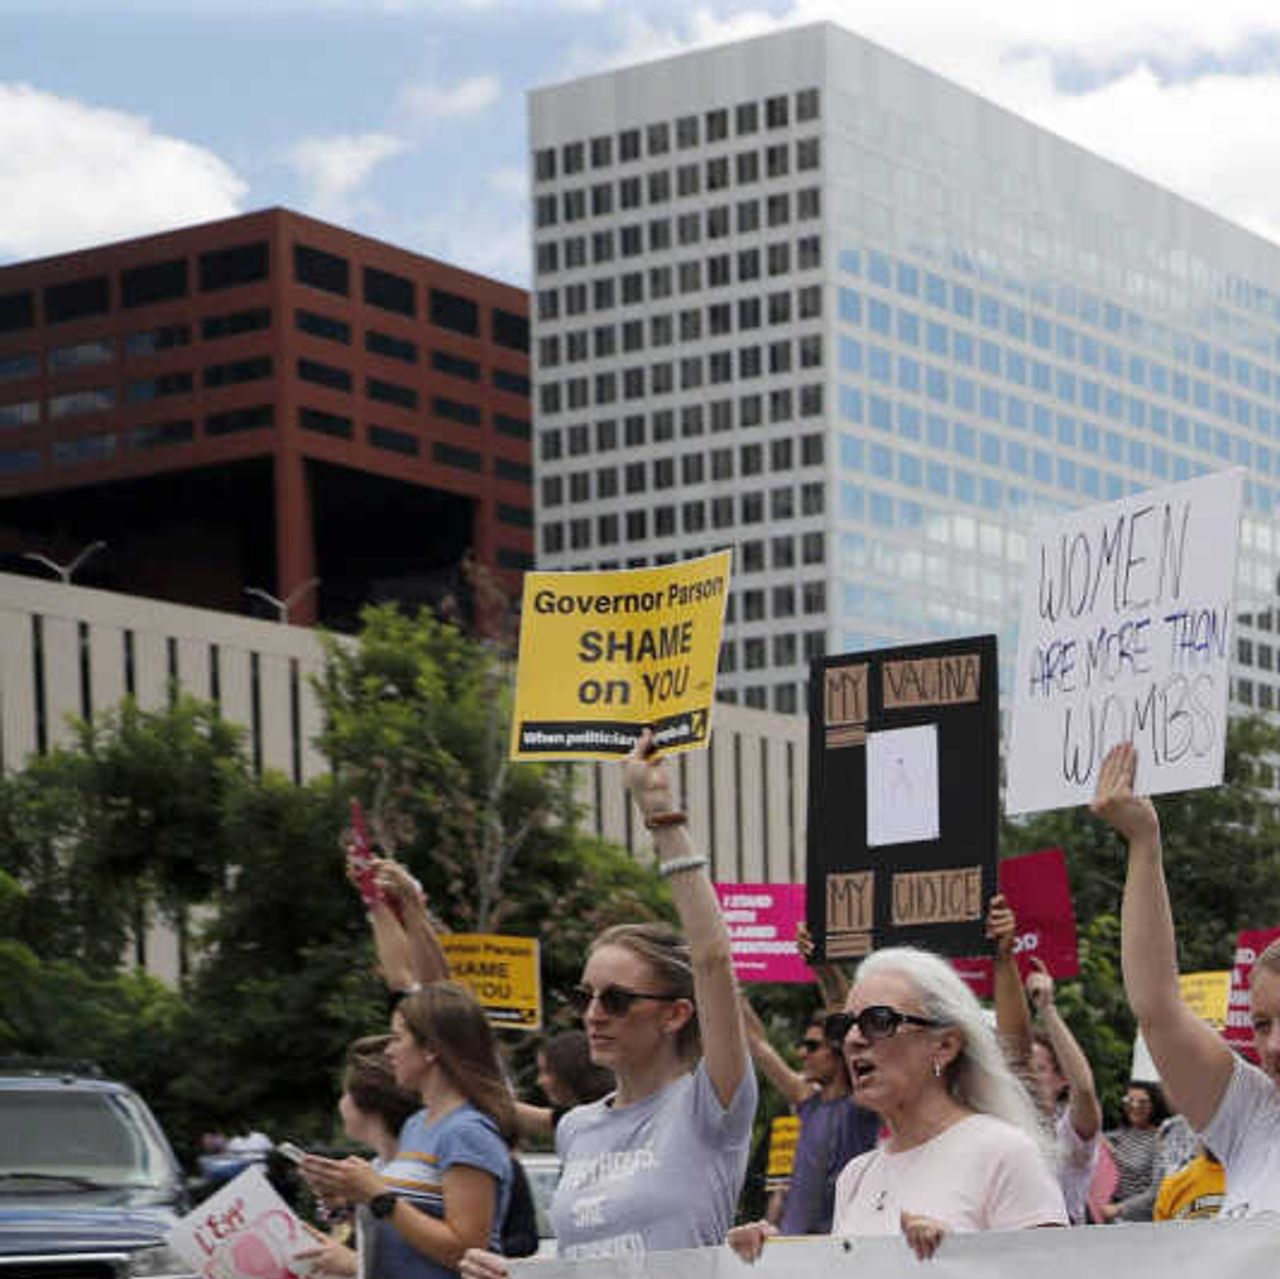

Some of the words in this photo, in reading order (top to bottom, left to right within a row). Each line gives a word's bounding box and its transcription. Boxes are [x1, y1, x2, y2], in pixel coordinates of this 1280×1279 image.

[1039, 499, 1192, 624] WOMEN
[534, 589, 665, 615] Governor
[667, 575, 724, 608] Parson
[578, 621, 694, 664] SHAME
[578, 678, 632, 705] on
[641, 664, 691, 705] YOU
[1030, 640, 1077, 698] ARE
[827, 671, 863, 717] MY
[830, 877, 868, 929] MY
